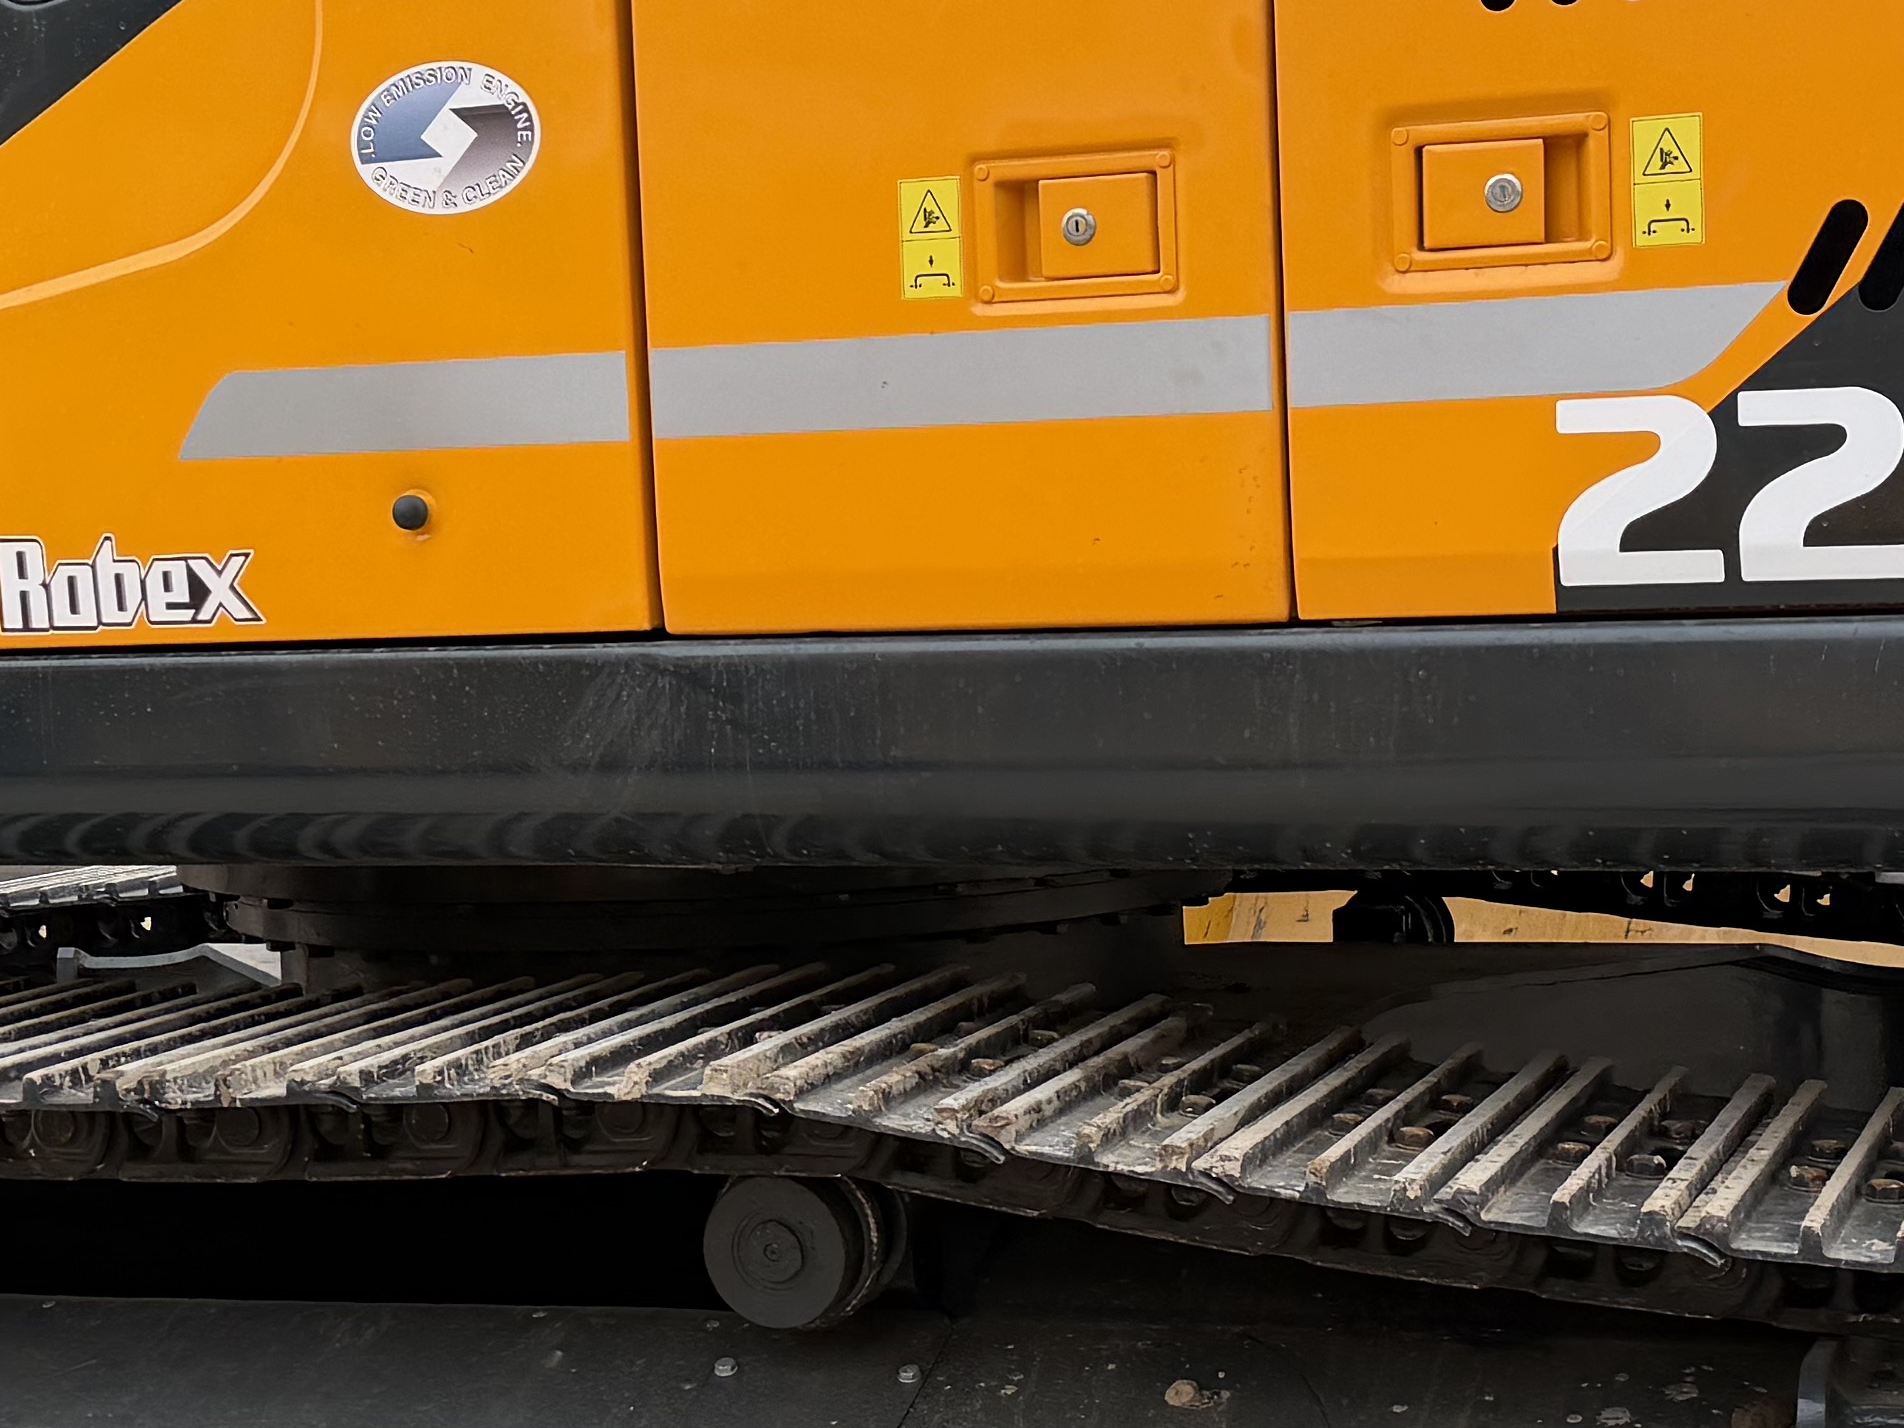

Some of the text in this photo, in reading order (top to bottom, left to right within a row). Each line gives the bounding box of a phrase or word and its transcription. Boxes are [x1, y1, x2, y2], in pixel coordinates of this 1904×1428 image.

[381, 65, 472, 108] EMISSION
[371, 153, 526, 209] GREEN & CLEAN
